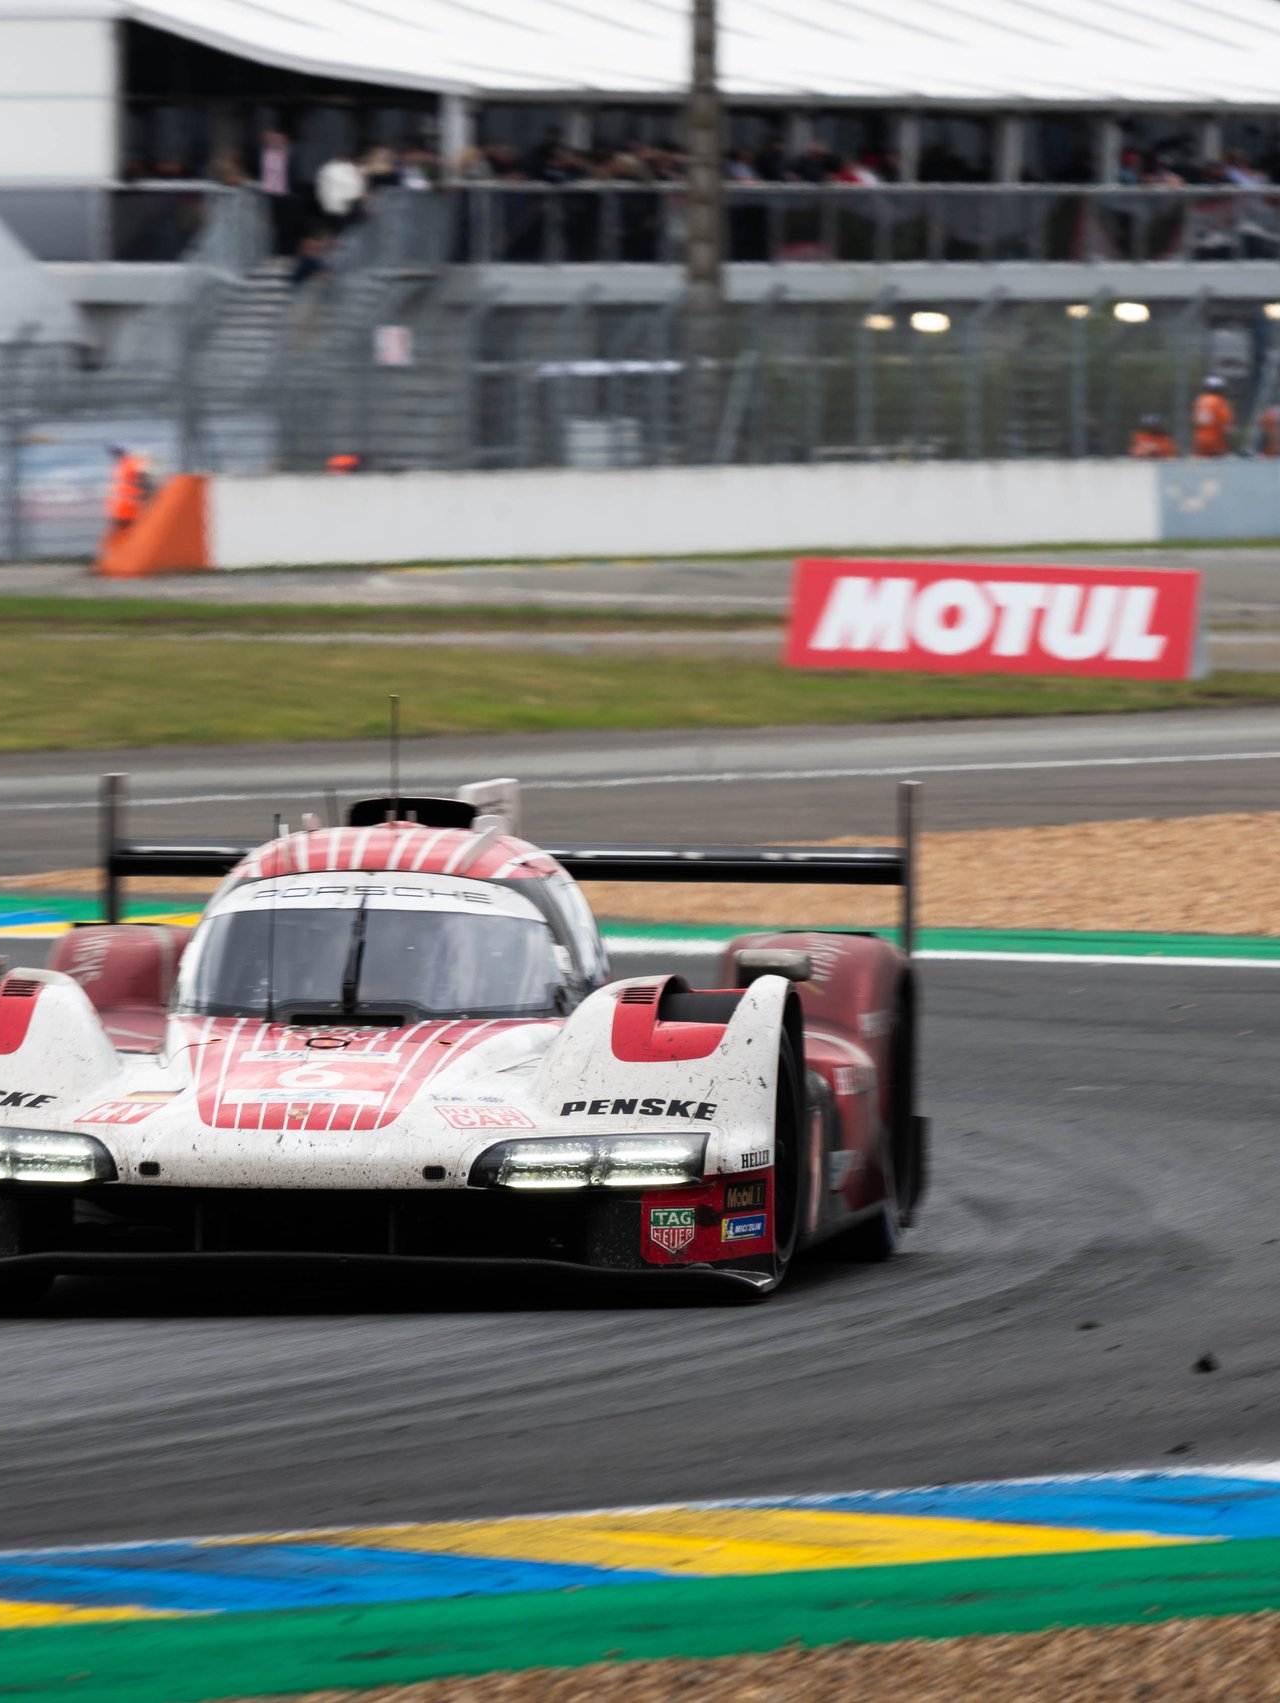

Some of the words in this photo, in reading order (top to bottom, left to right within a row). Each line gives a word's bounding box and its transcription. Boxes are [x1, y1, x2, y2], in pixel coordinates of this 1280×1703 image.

[808, 576, 1167, 661] MOTUL
[253, 885, 495, 905] PORSCHE
[277, 1062, 346, 1089] 6
[451, 1114, 528, 1127] CAR
[560, 1098, 718, 1121] PENSKE
[727, 1184, 754, 1209] Mobil
[655, 1212, 692, 1225] TAG
[653, 1227, 693, 1249] HEUER
